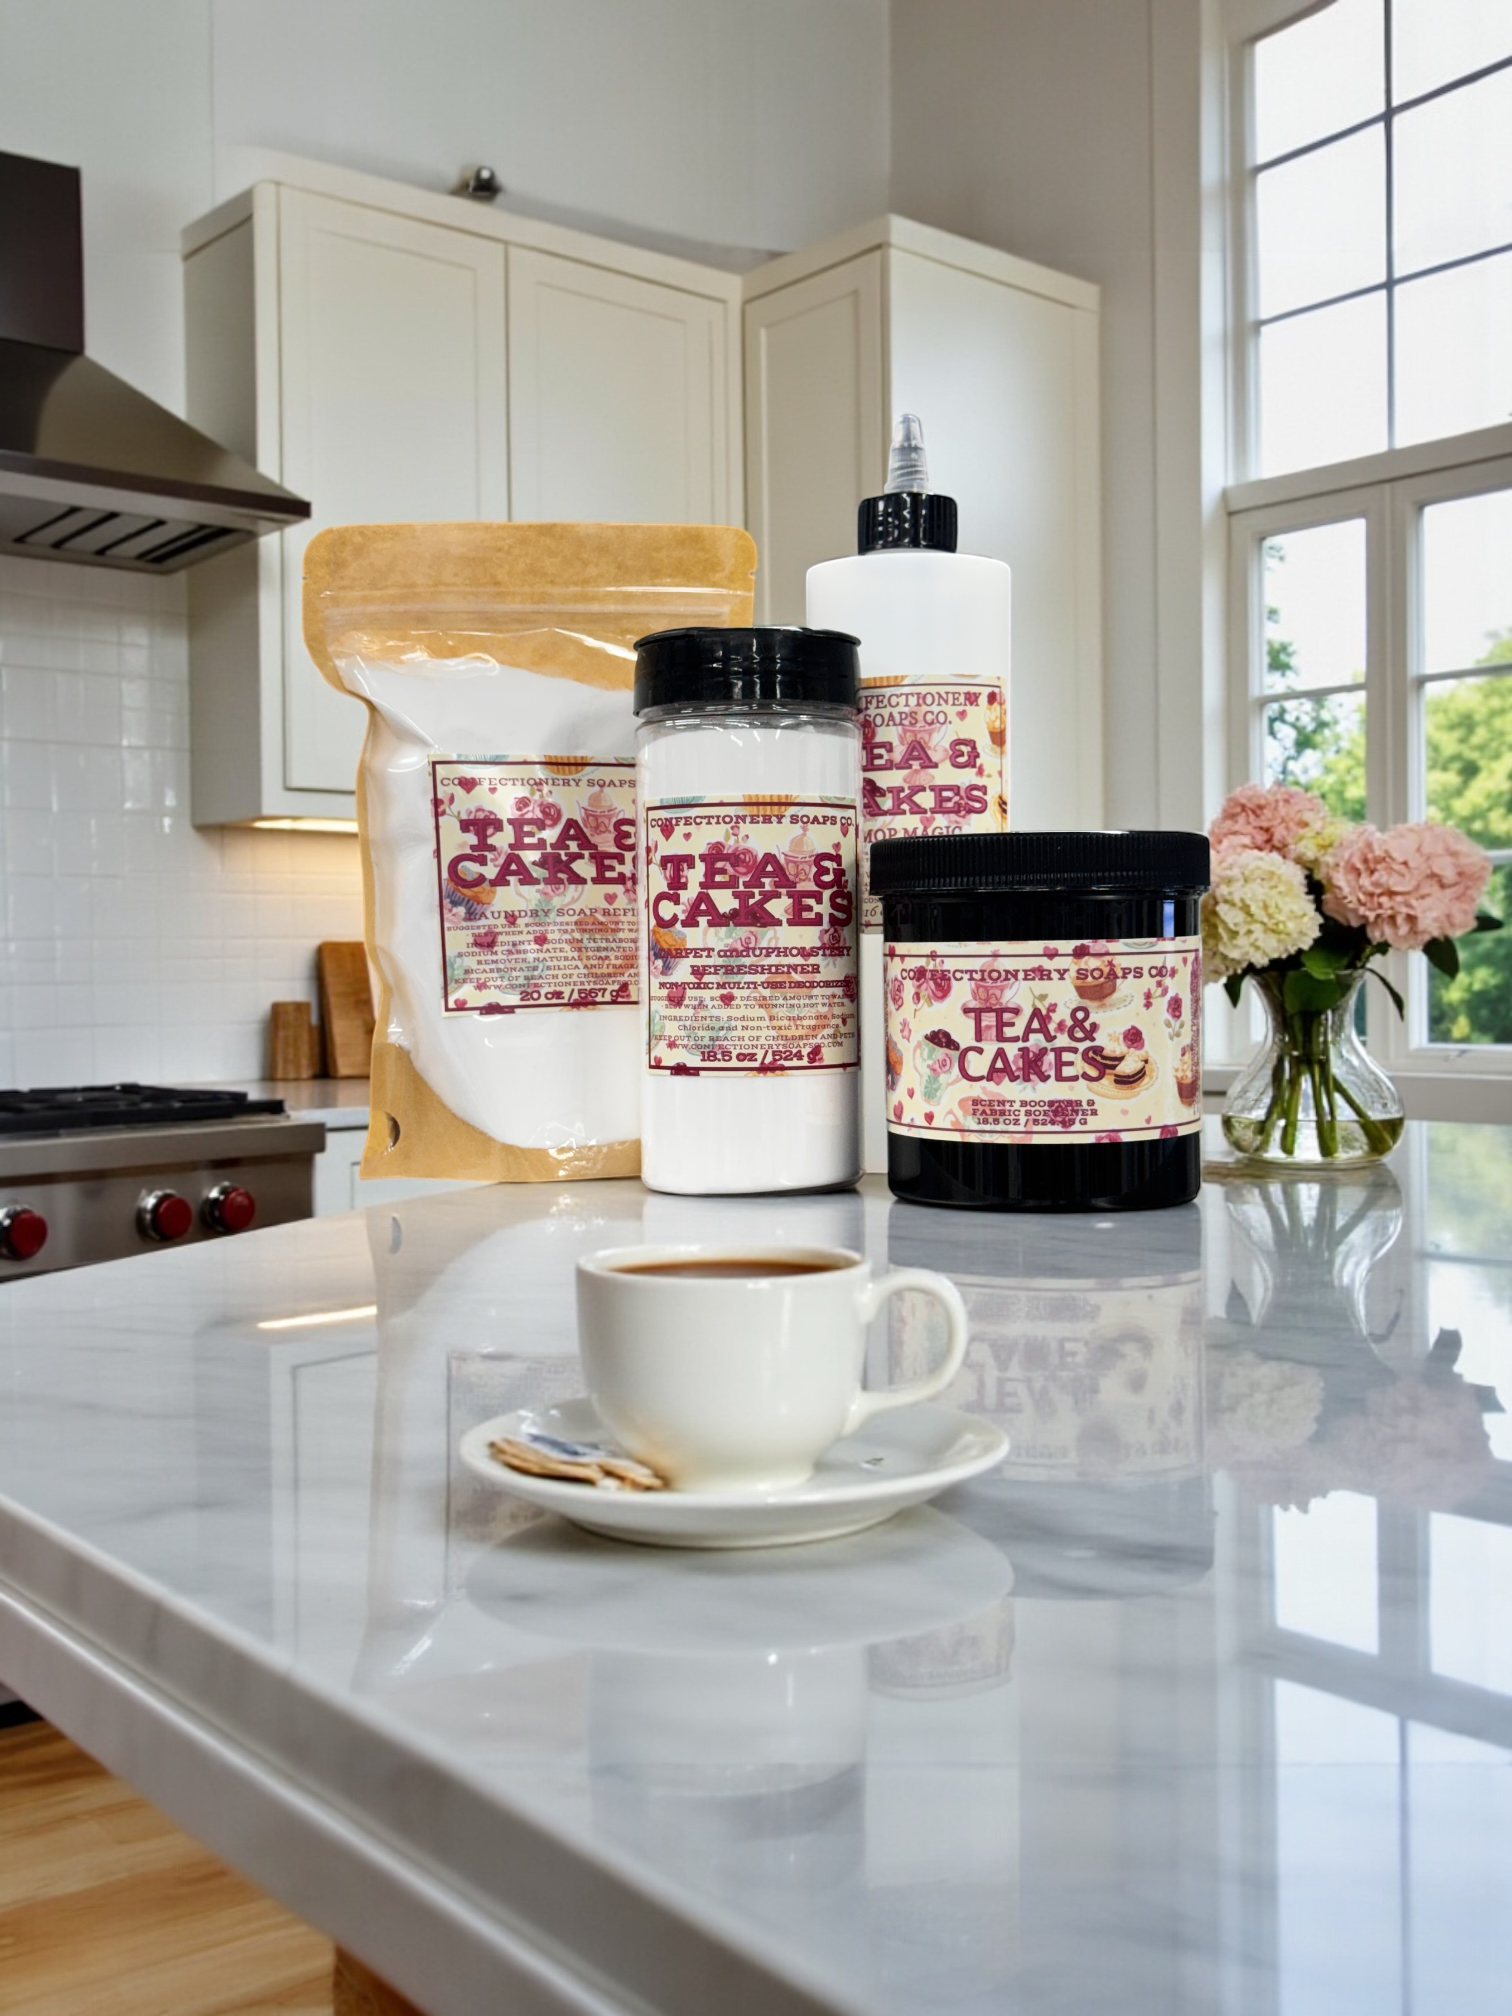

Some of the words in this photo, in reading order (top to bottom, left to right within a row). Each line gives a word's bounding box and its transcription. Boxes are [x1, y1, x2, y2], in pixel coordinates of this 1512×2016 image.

[864, 711, 918, 728] SOAPS
[923, 711, 952, 725] CO.
[949, 739, 980, 769] &
[440, 777, 582, 788] CONFECTIONERY
[587, 779, 636, 788] SOAPS
[650, 814, 785, 828] CONFECTIONERY
[789, 814, 838, 826] SOAPS
[840, 816, 855, 827] CO.
[459, 818, 598, 852] TEA
[447, 852, 637, 889] CAKE
[660, 852, 797, 890] TEA
[813, 852, 846, 889] &
[556, 908, 598, 917] SOAP
[652, 890, 854, 929] CAKES
[457, 950, 498, 958] SODIUM
[659, 947, 715, 958] CARPET
[533, 955, 583, 963] NATURAL
[690, 964, 821, 976] REFRESHENER
[900, 968, 1070, 982] CONFECTIONERY
[1075, 967, 1144, 981] SOAPS
[658, 981, 714, 990] NON-TOXIC
[715, 981, 786, 990] MULTI-USE
[788, 979, 853, 989] DEODORIZE
[519, 990, 541, 1001] 20
[544, 989, 565, 1000] oz
[577, 988, 608, 999] 567
[963, 1007, 1057, 1043] TEA
[1067, 1006, 1096, 1043] &
[700, 1050, 732, 1062] 18.5
[735, 1052, 758, 1062] oz
[771, 1050, 805, 1062] 524
[958, 1045, 1106, 1082] CAKES
[971, 1099, 1016, 1107] SCENT
[1019, 1099, 1083, 1107] BOOSTER
[1086, 1098, 1096, 1107] &
[972, 1108, 1021, 1117] FABRIC
[1024, 1108, 1099, 1117] SOFENER
[976, 1117, 1000, 1126] 18.5
[1002, 1118, 1021, 1126] OZ
[1079, 1117, 1088, 1126] G
